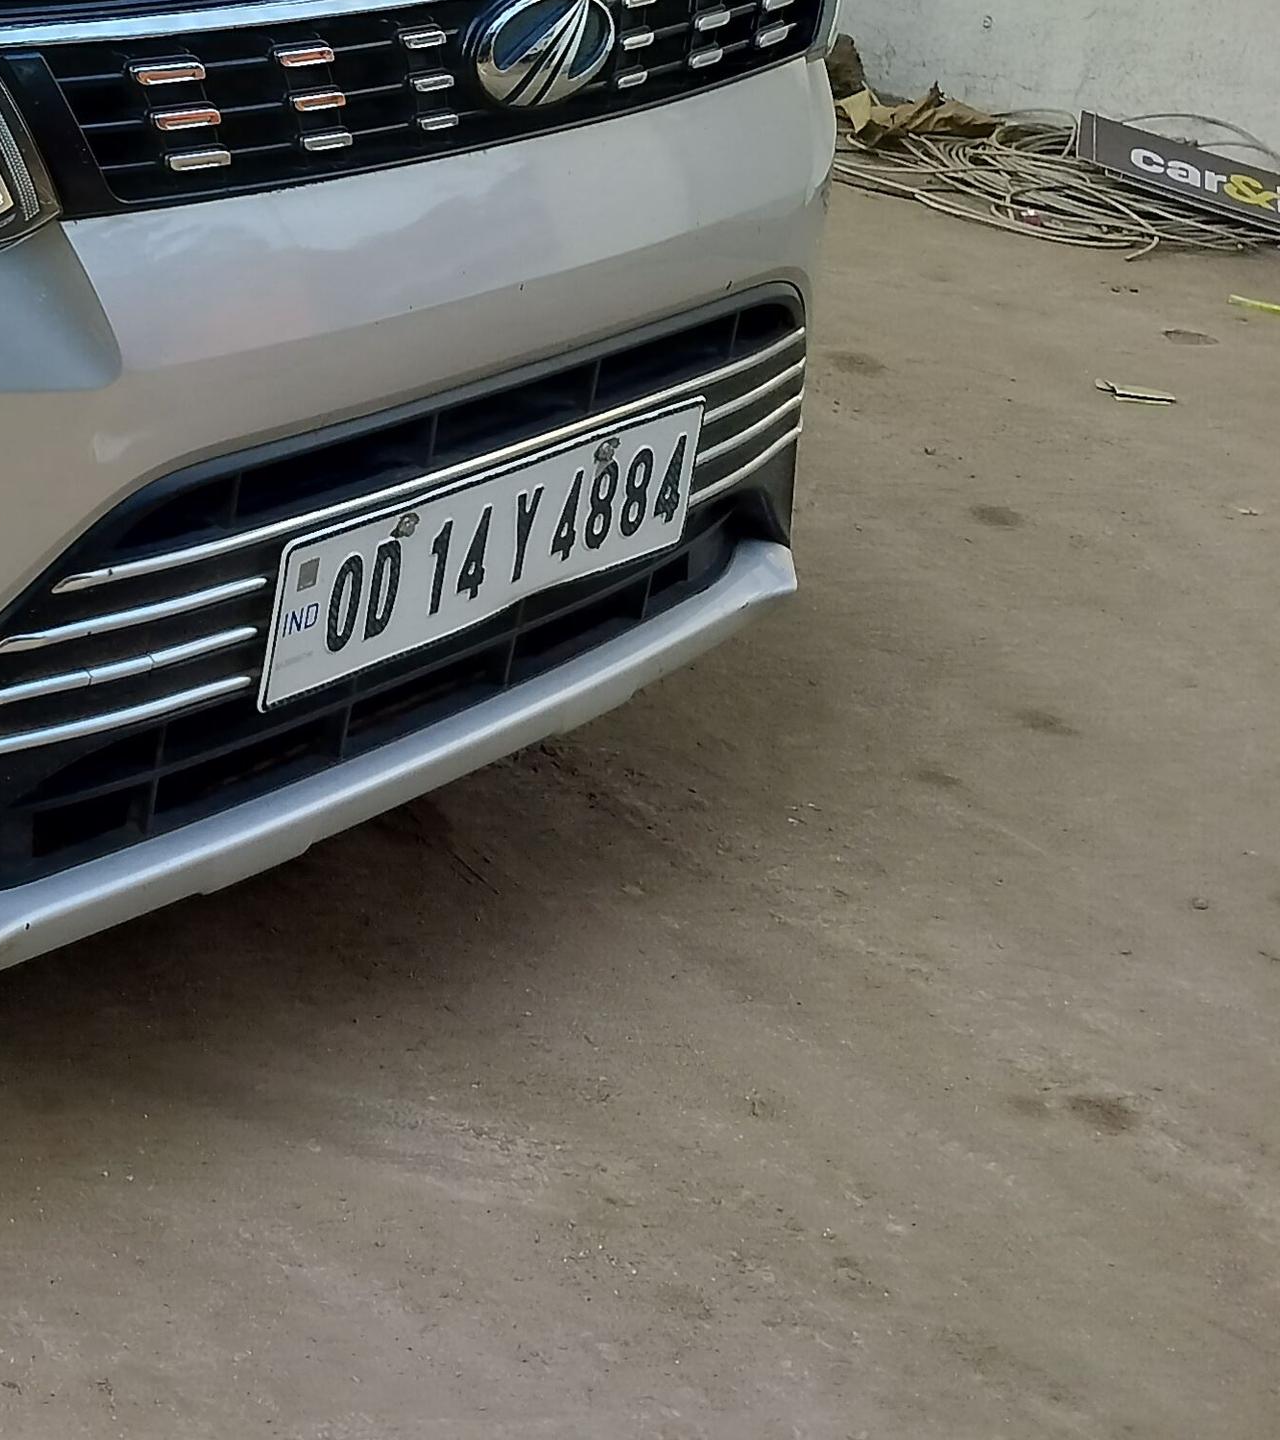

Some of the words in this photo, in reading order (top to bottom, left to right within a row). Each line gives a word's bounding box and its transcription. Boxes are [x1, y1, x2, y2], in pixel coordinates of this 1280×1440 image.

[1130, 148, 1280, 214] car&
[326, 539, 402, 653] OD
[429, 505, 492, 616] 14
[550, 434, 687, 562] 4884
[282, 602, 319, 638] IND
